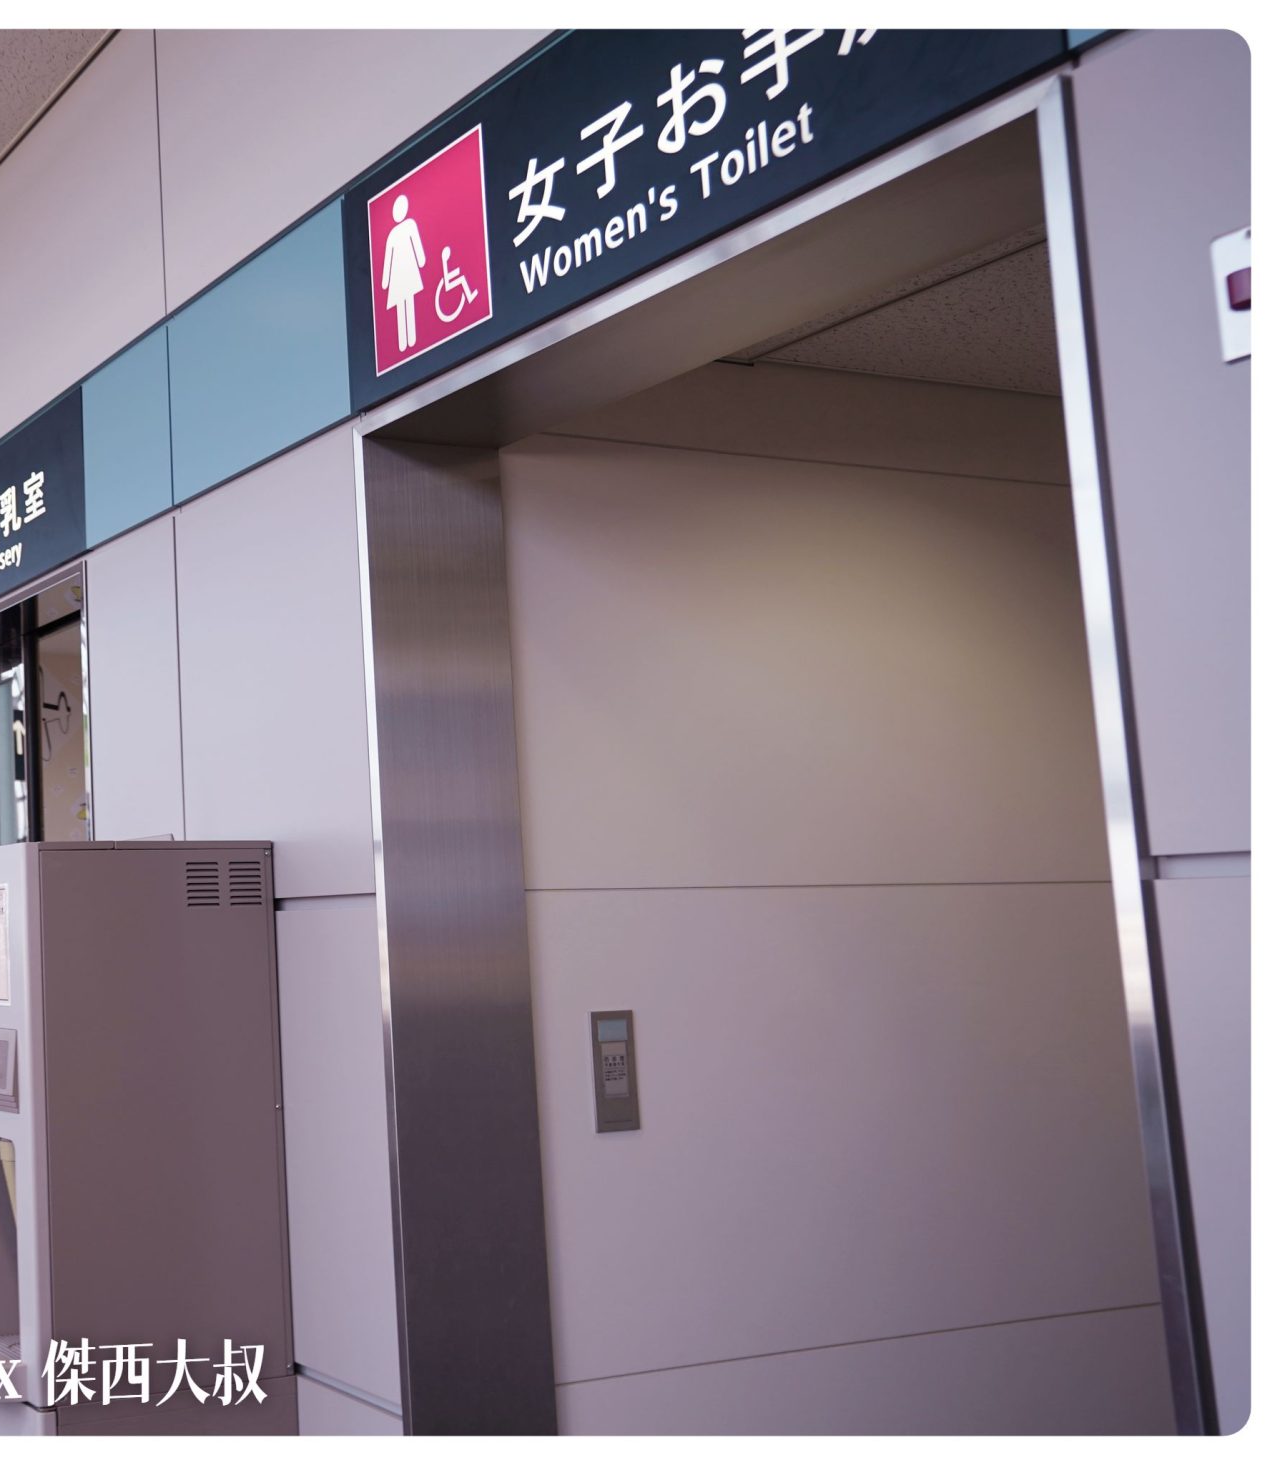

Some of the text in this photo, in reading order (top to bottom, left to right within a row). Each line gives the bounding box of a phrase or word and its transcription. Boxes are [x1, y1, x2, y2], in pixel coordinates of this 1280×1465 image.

[509, 29, 878, 247] 女子お手
[520, 102, 815, 294] Women's Toilet
